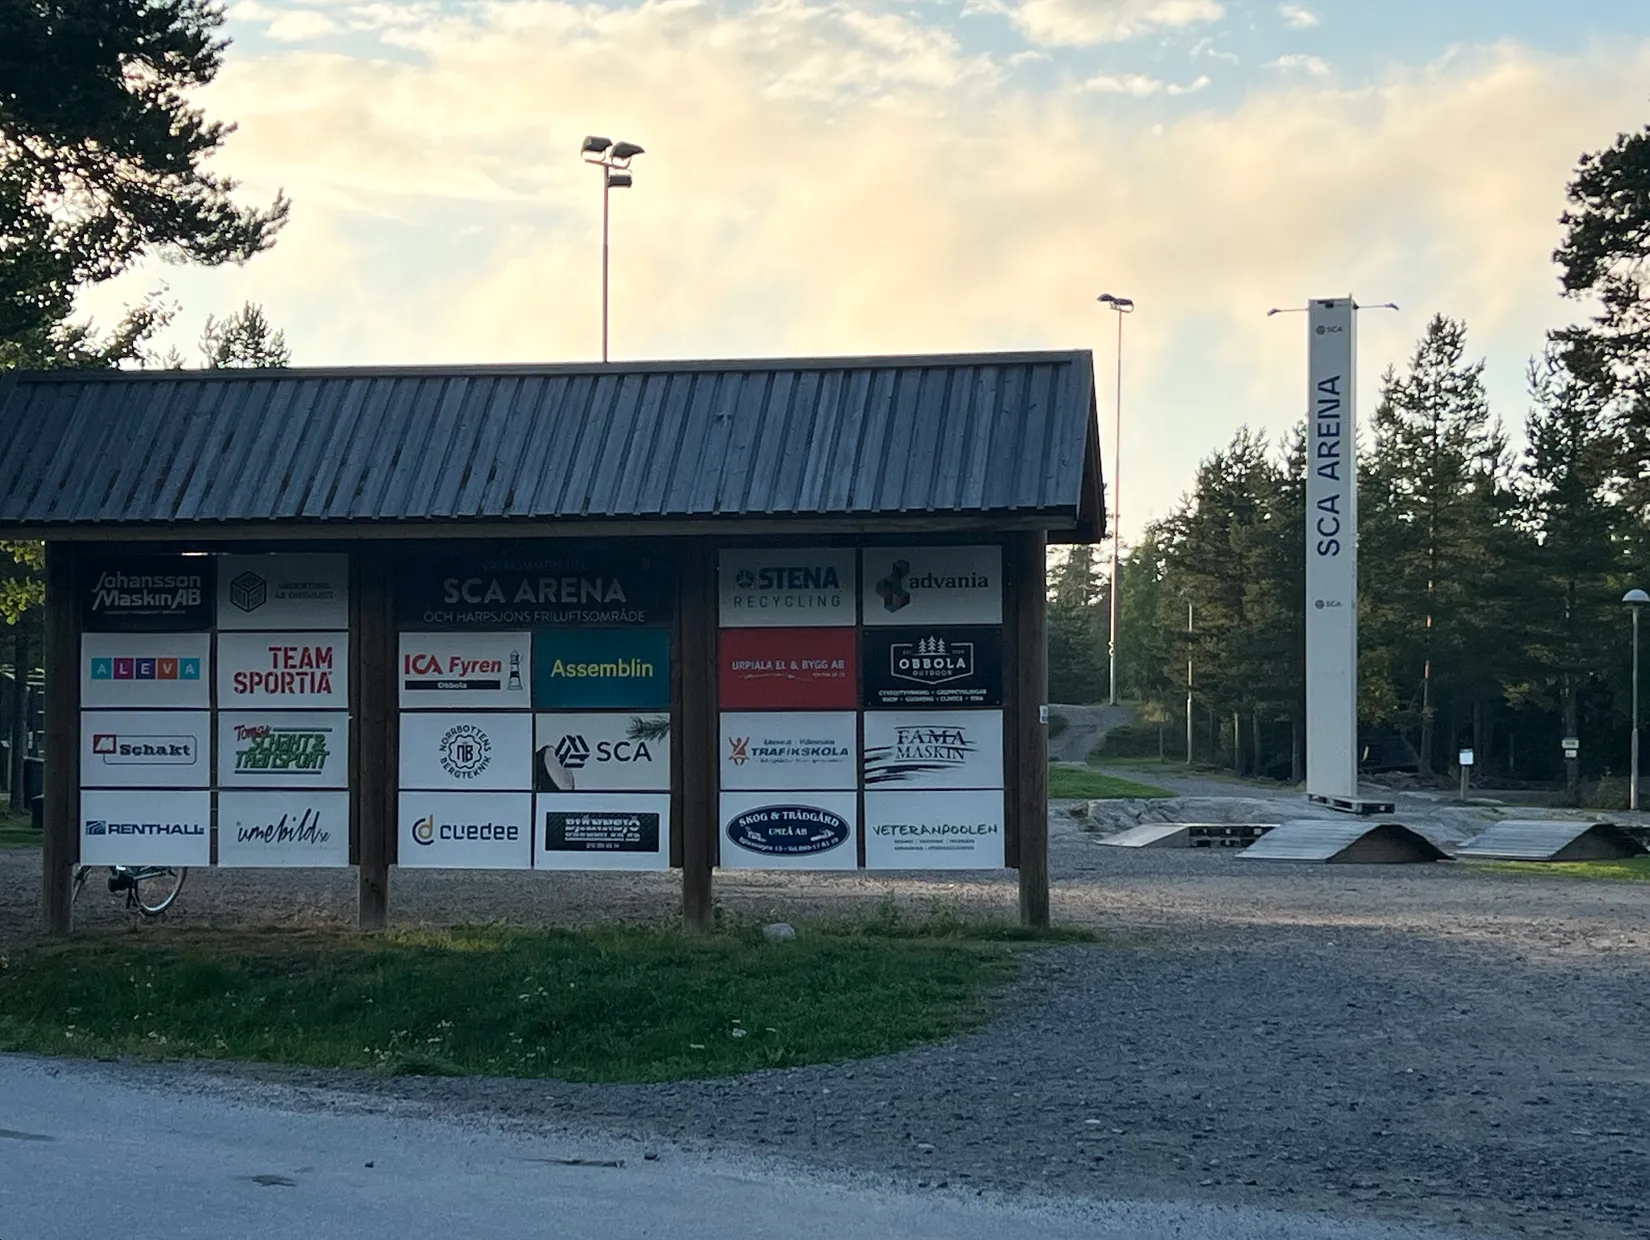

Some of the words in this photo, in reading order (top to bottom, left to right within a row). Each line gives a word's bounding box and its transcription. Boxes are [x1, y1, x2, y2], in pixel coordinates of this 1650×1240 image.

[1327, 326, 1343, 334] SCA
[1317, 375, 1341, 482] ARENA
[1317, 493, 1341, 557] SCA
[91, 571, 202, 592] Johansson
[758, 566, 841, 590] STENA
[908, 572, 989, 590] advania
[443, 577, 507, 604] SCA
[513, 577, 628, 604] ARENA
[733, 595, 841, 609] RECYCLING
[1326, 600, 1342, 608] SCA
[423, 610, 453, 623] OCH
[533, 607, 646, 623] FRILUFTSOMRÅDE
[268, 646, 334, 670] TEAM
[404, 654, 443, 675] ICA
[450, 655, 502, 678] Fyren
[776, 660, 786, 671] EL
[790, 660, 799, 671] &
[801, 659, 829, 670] BYGG
[831, 659, 845, 670] AB
[899, 658, 966, 670] OBBOLA
[96, 660, 196, 675] ALEVA
[550, 658, 654, 678] Assemblin
[233, 671, 334, 694] SPORTIA
[439, 724, 493, 753] NORRBOTTENS
[896, 729, 967, 747] FAMA
[119, 744, 190, 756] Schakt
[596, 741, 653, 763] SCA
[750, 747, 849, 756] TRAFIKSKOLA
[896, 745, 965, 760] MASKIN
[440, 755, 492, 780] BERGTEKNIK
[738, 813, 769, 828] SKOG
[770, 811, 781, 820] &
[108, 823, 205, 835] RENTHALL
[439, 823, 519, 840] cuedee
[795, 828, 808, 836] AB
[872, 823, 998, 837] VETERANPOOLEN
